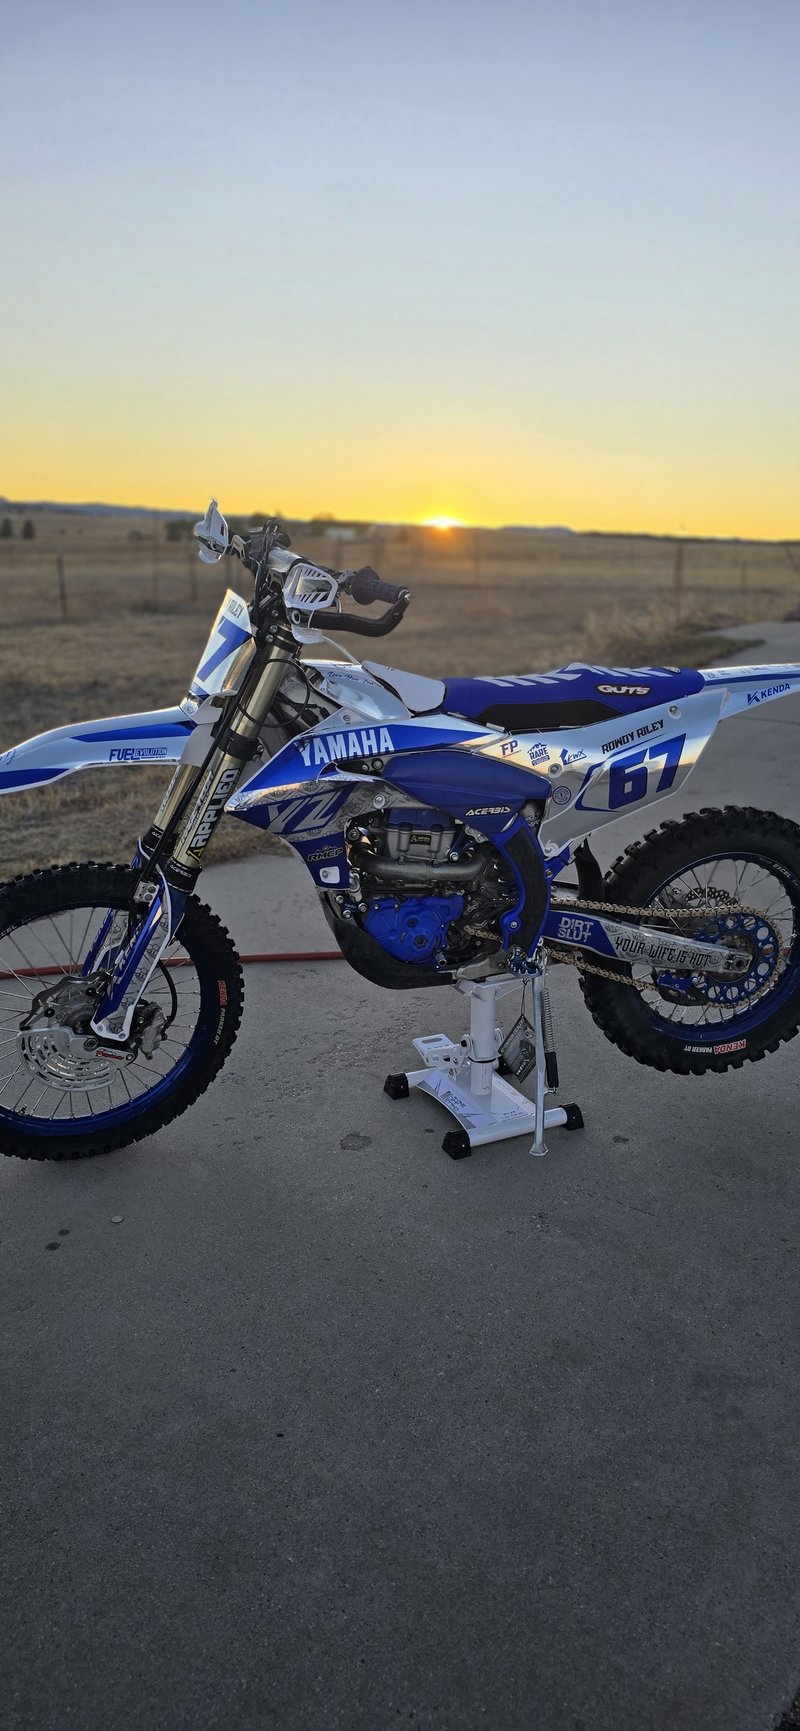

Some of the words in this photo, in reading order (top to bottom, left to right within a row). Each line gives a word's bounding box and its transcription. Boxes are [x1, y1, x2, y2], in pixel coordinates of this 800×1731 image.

[597, 684, 651, 695] GUTS
[760, 683, 791, 699] KENDA
[601, 732, 635, 755] ROWDY
[636, 719, 664, 739] RILEY
[109, 747, 140, 762] FUEL
[293, 727, 395, 767] YAMAHA
[500, 739, 518, 756] FP
[529, 746, 548, 761] RARE
[608, 732, 687, 810] 67
[189, 768, 241, 849] APPLIED
[266, 787, 346, 834] YZ
[465, 805, 511, 817] ACERBIS
[559, 916, 594, 932] DIRT
[557, 927, 592, 943] SLUT
[615, 936, 646, 955] YOUR
[648, 943, 676, 961] WIFE
[676, 949, 687, 964] IS
[689, 951, 712, 968] HOT
[217, 979, 228, 1008] KENDA
[713, 1038, 747, 1055] KENDA
